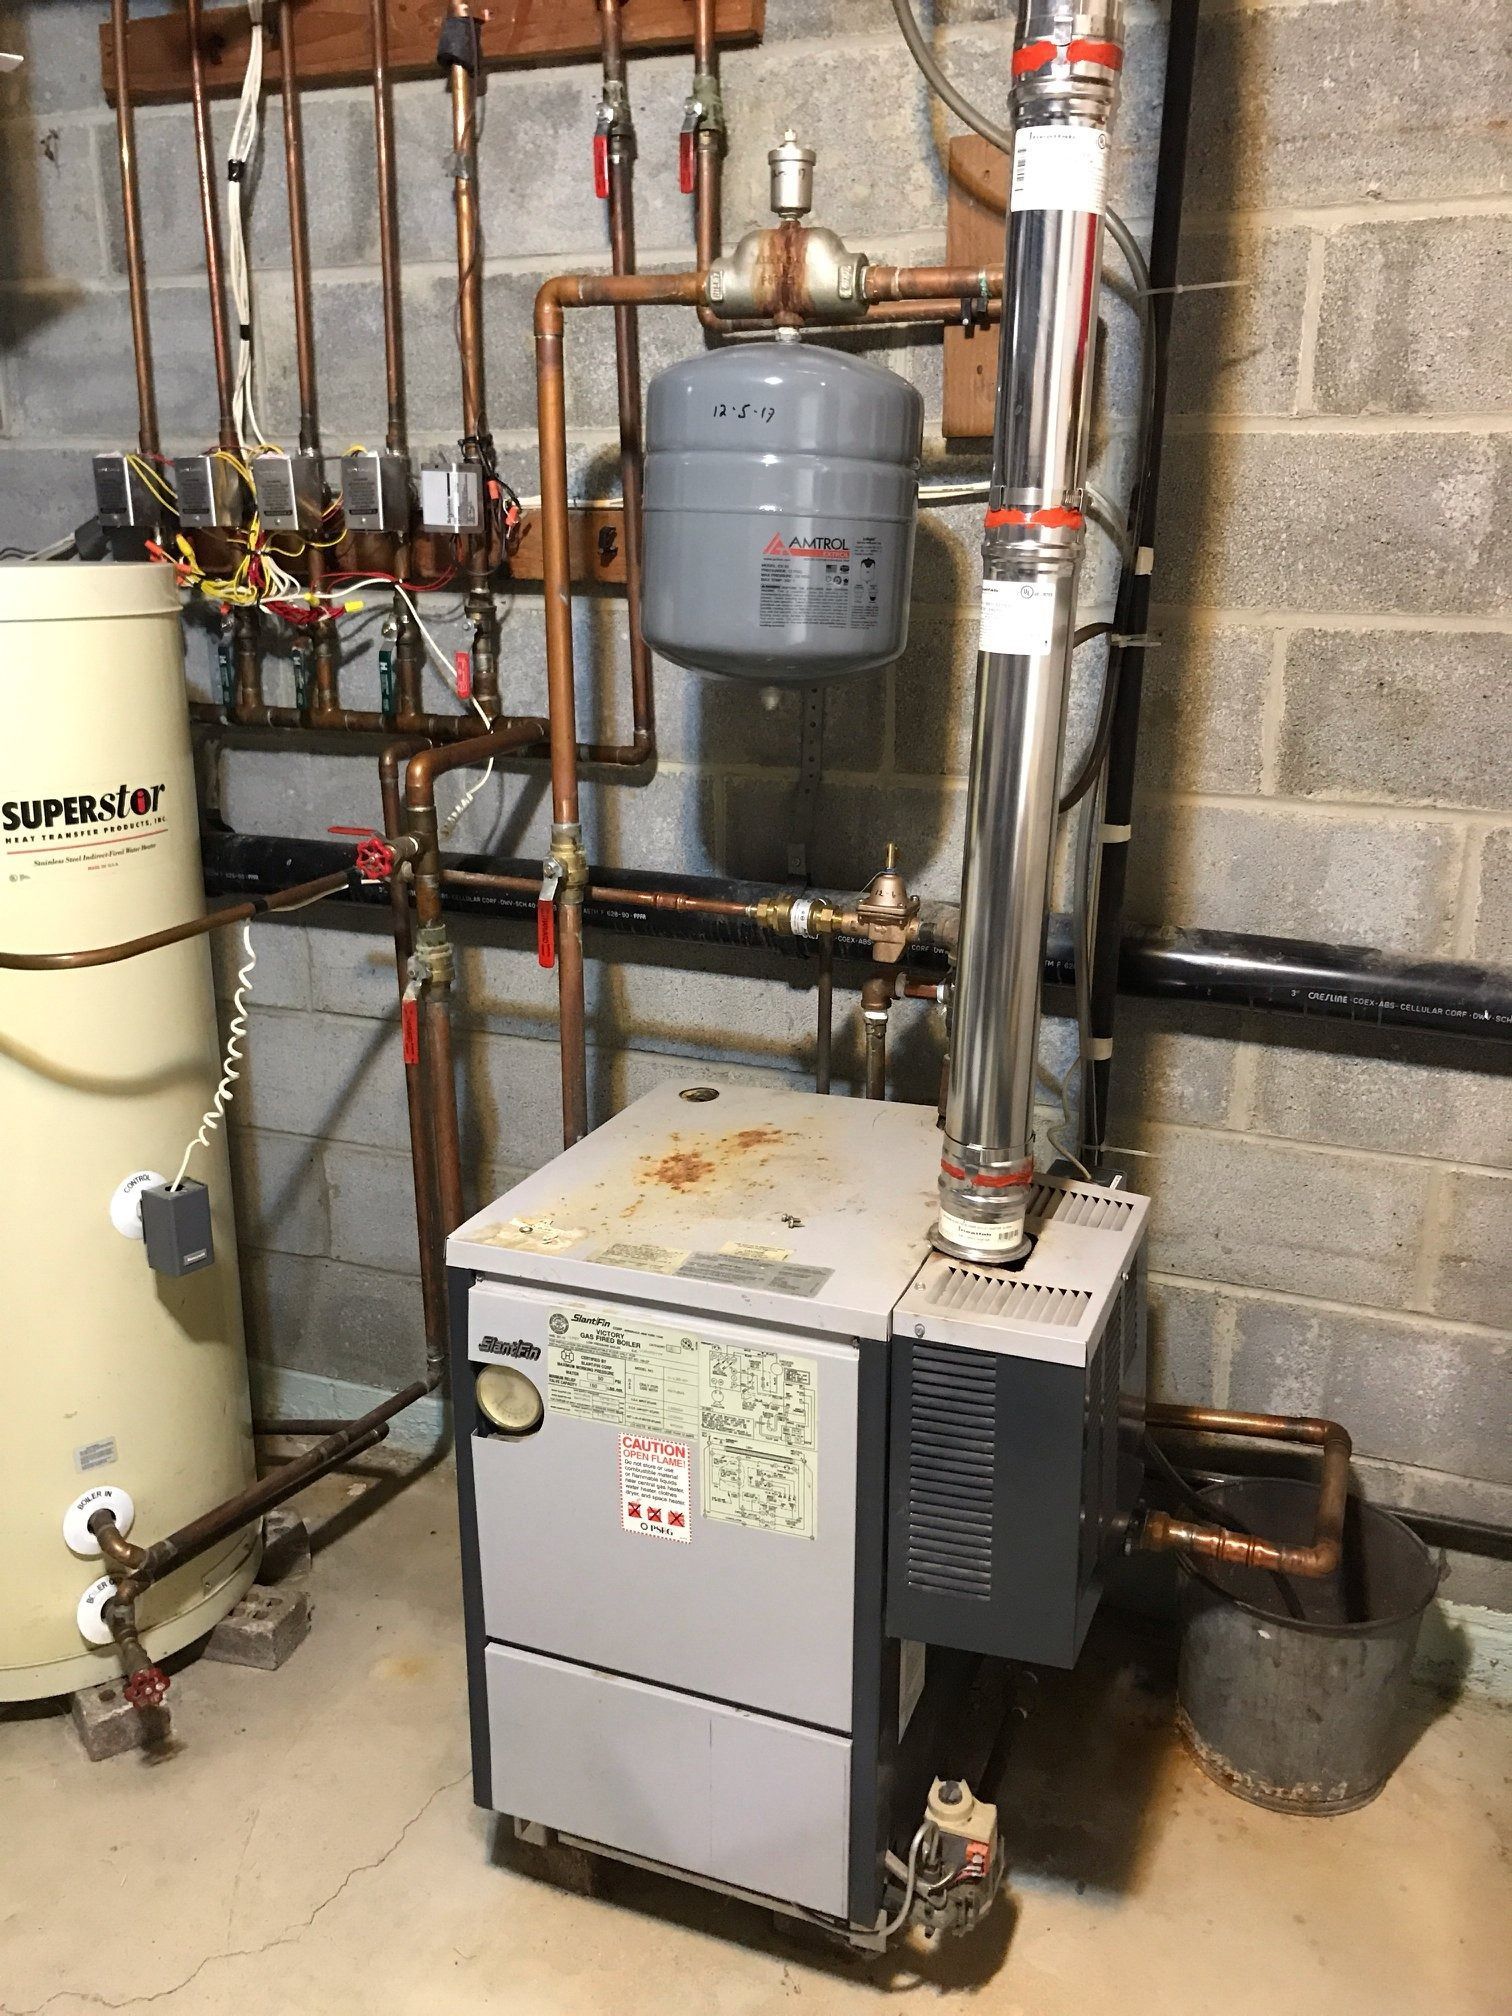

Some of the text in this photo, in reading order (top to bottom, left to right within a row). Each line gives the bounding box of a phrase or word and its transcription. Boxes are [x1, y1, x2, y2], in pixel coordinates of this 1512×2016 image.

[789, 536, 850, 550] AMTROL
[5, 835, 35, 844] HEAT
[42, 829, 98, 841] TRANSFER
[34, 858, 64, 867] Stainless
[66, 855, 82, 863] Steel
[126, 846, 140, 854] Water
[1308, 991, 1348, 1004] CRESLINE
[1400, 1003, 1443, 1015] CELLULAR
[123, 1173, 151, 1193] CONTROL
[580, 1332, 594, 1340] GAS
[596, 1335, 615, 1344] FIRED
[617, 1339, 641, 1349] BOILER
[596, 1329, 625, 1339] VICTORY
[622, 1436, 686, 1458] CAUTION
[623, 1449, 686, 1468] OPEN FLAME!
[625, 1466, 678, 1480] combustible material
[632, 1472, 658, 1482] flammable
[77, 1490, 112, 1510] BOILER IN
[658, 1490, 677, 1498] clothes
[86, 1581, 108, 1604] BOER
